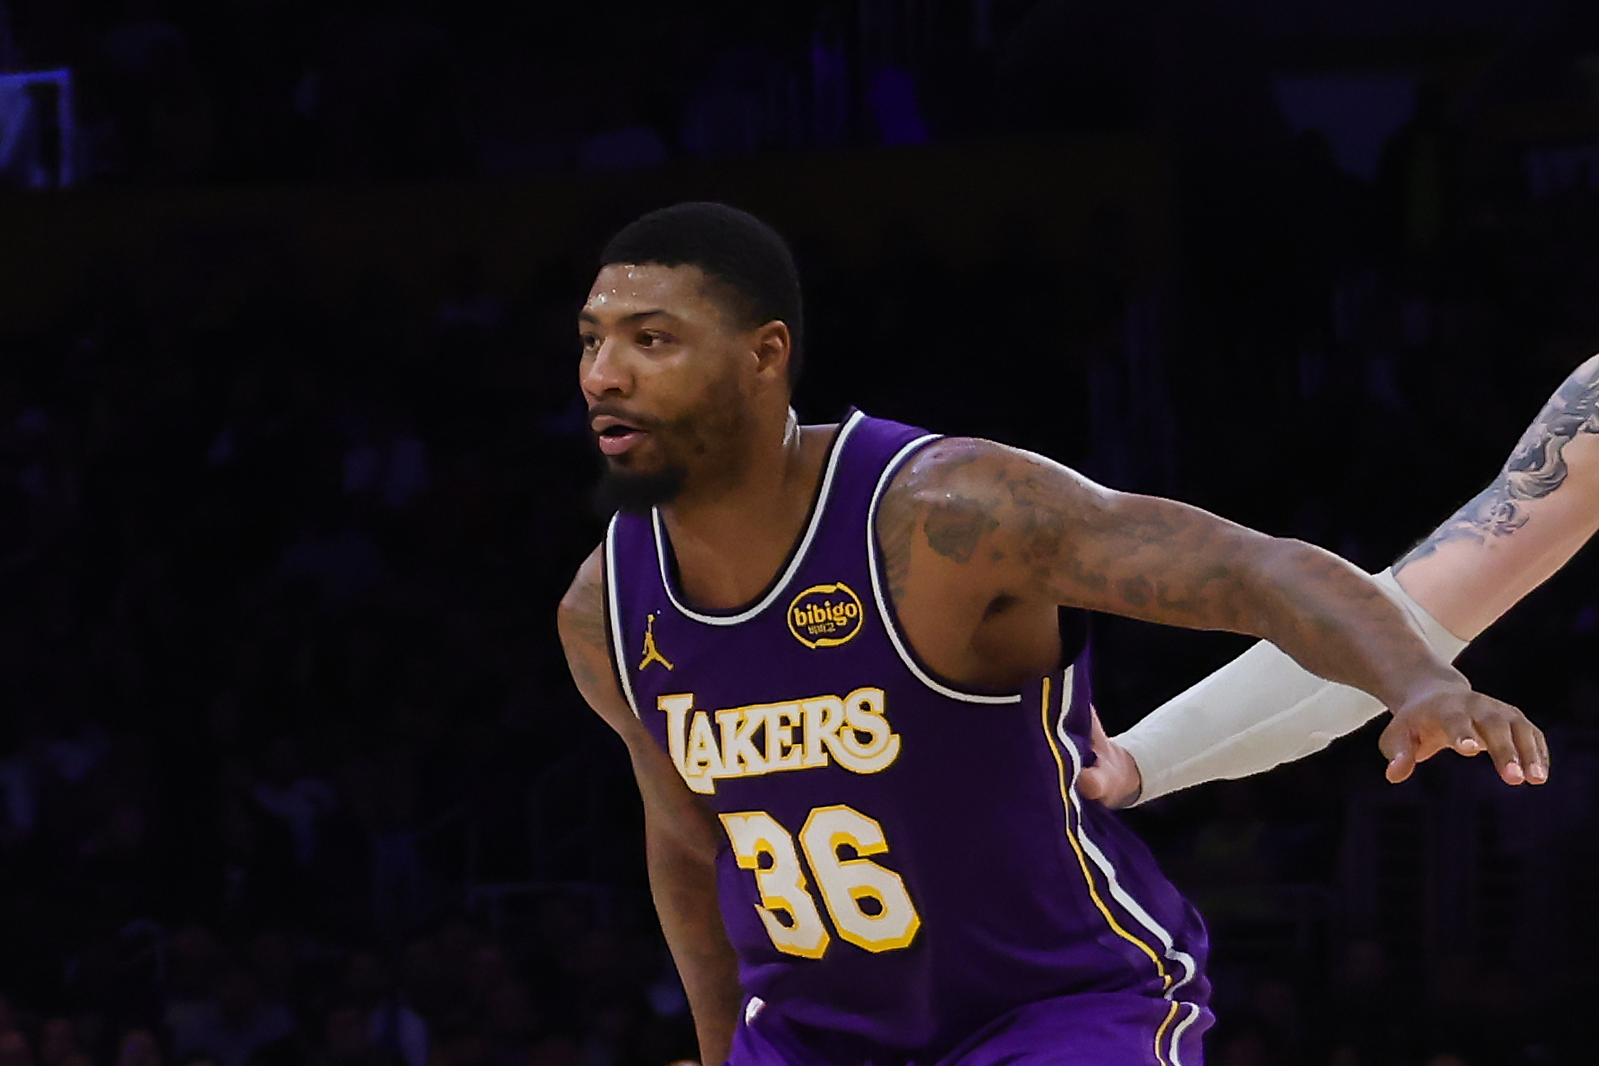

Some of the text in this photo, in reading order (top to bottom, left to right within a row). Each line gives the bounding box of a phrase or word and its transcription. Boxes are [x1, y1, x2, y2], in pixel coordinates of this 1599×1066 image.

[793, 600, 858, 627] bibigo
[656, 685, 901, 795] LAKERS
[717, 803, 922, 961] 36
